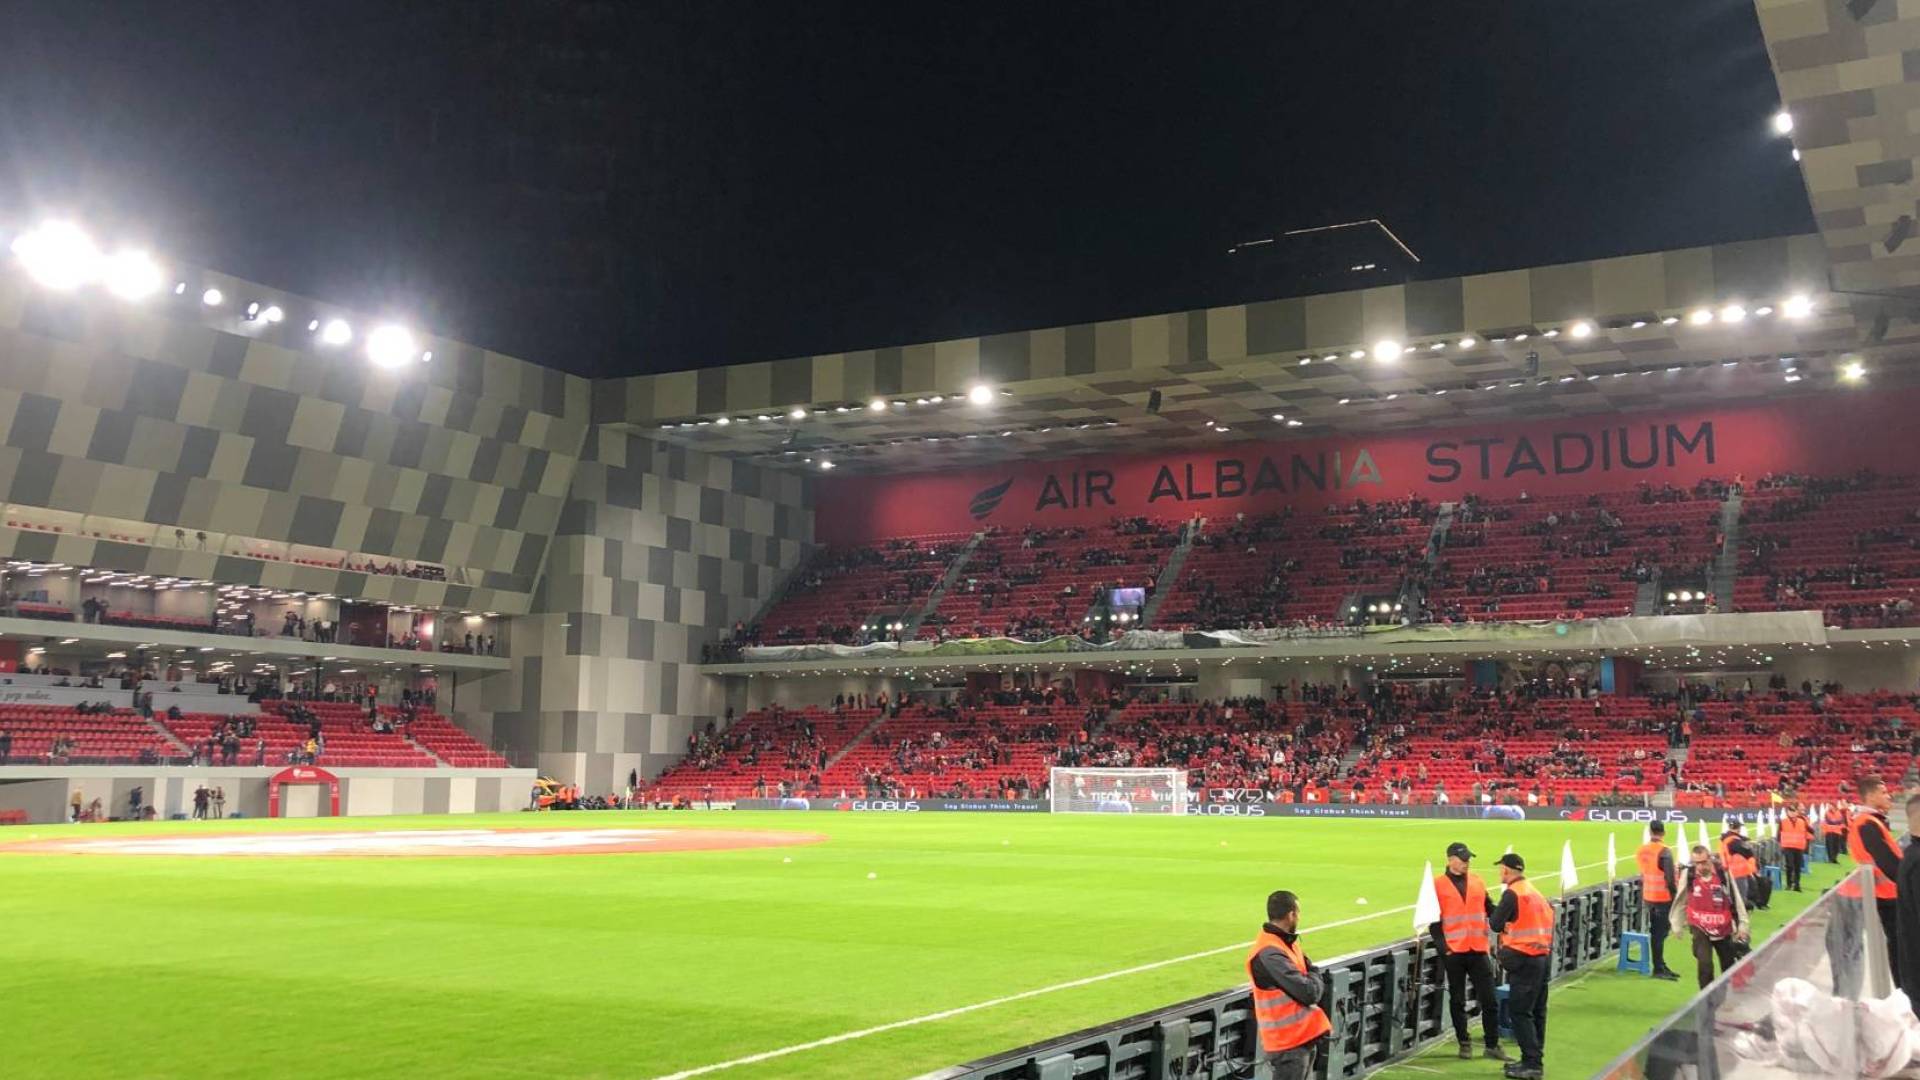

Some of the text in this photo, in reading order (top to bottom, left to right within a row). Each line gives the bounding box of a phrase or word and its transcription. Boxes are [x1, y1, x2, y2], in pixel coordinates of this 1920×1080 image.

[1035, 422, 1715, 511] AIR ALBANIA STADIUM
[852, 801, 920, 812] GLOBUS
[1185, 804, 1264, 816] GLOBUS
[1588, 809, 1687, 822] GLOBUS
